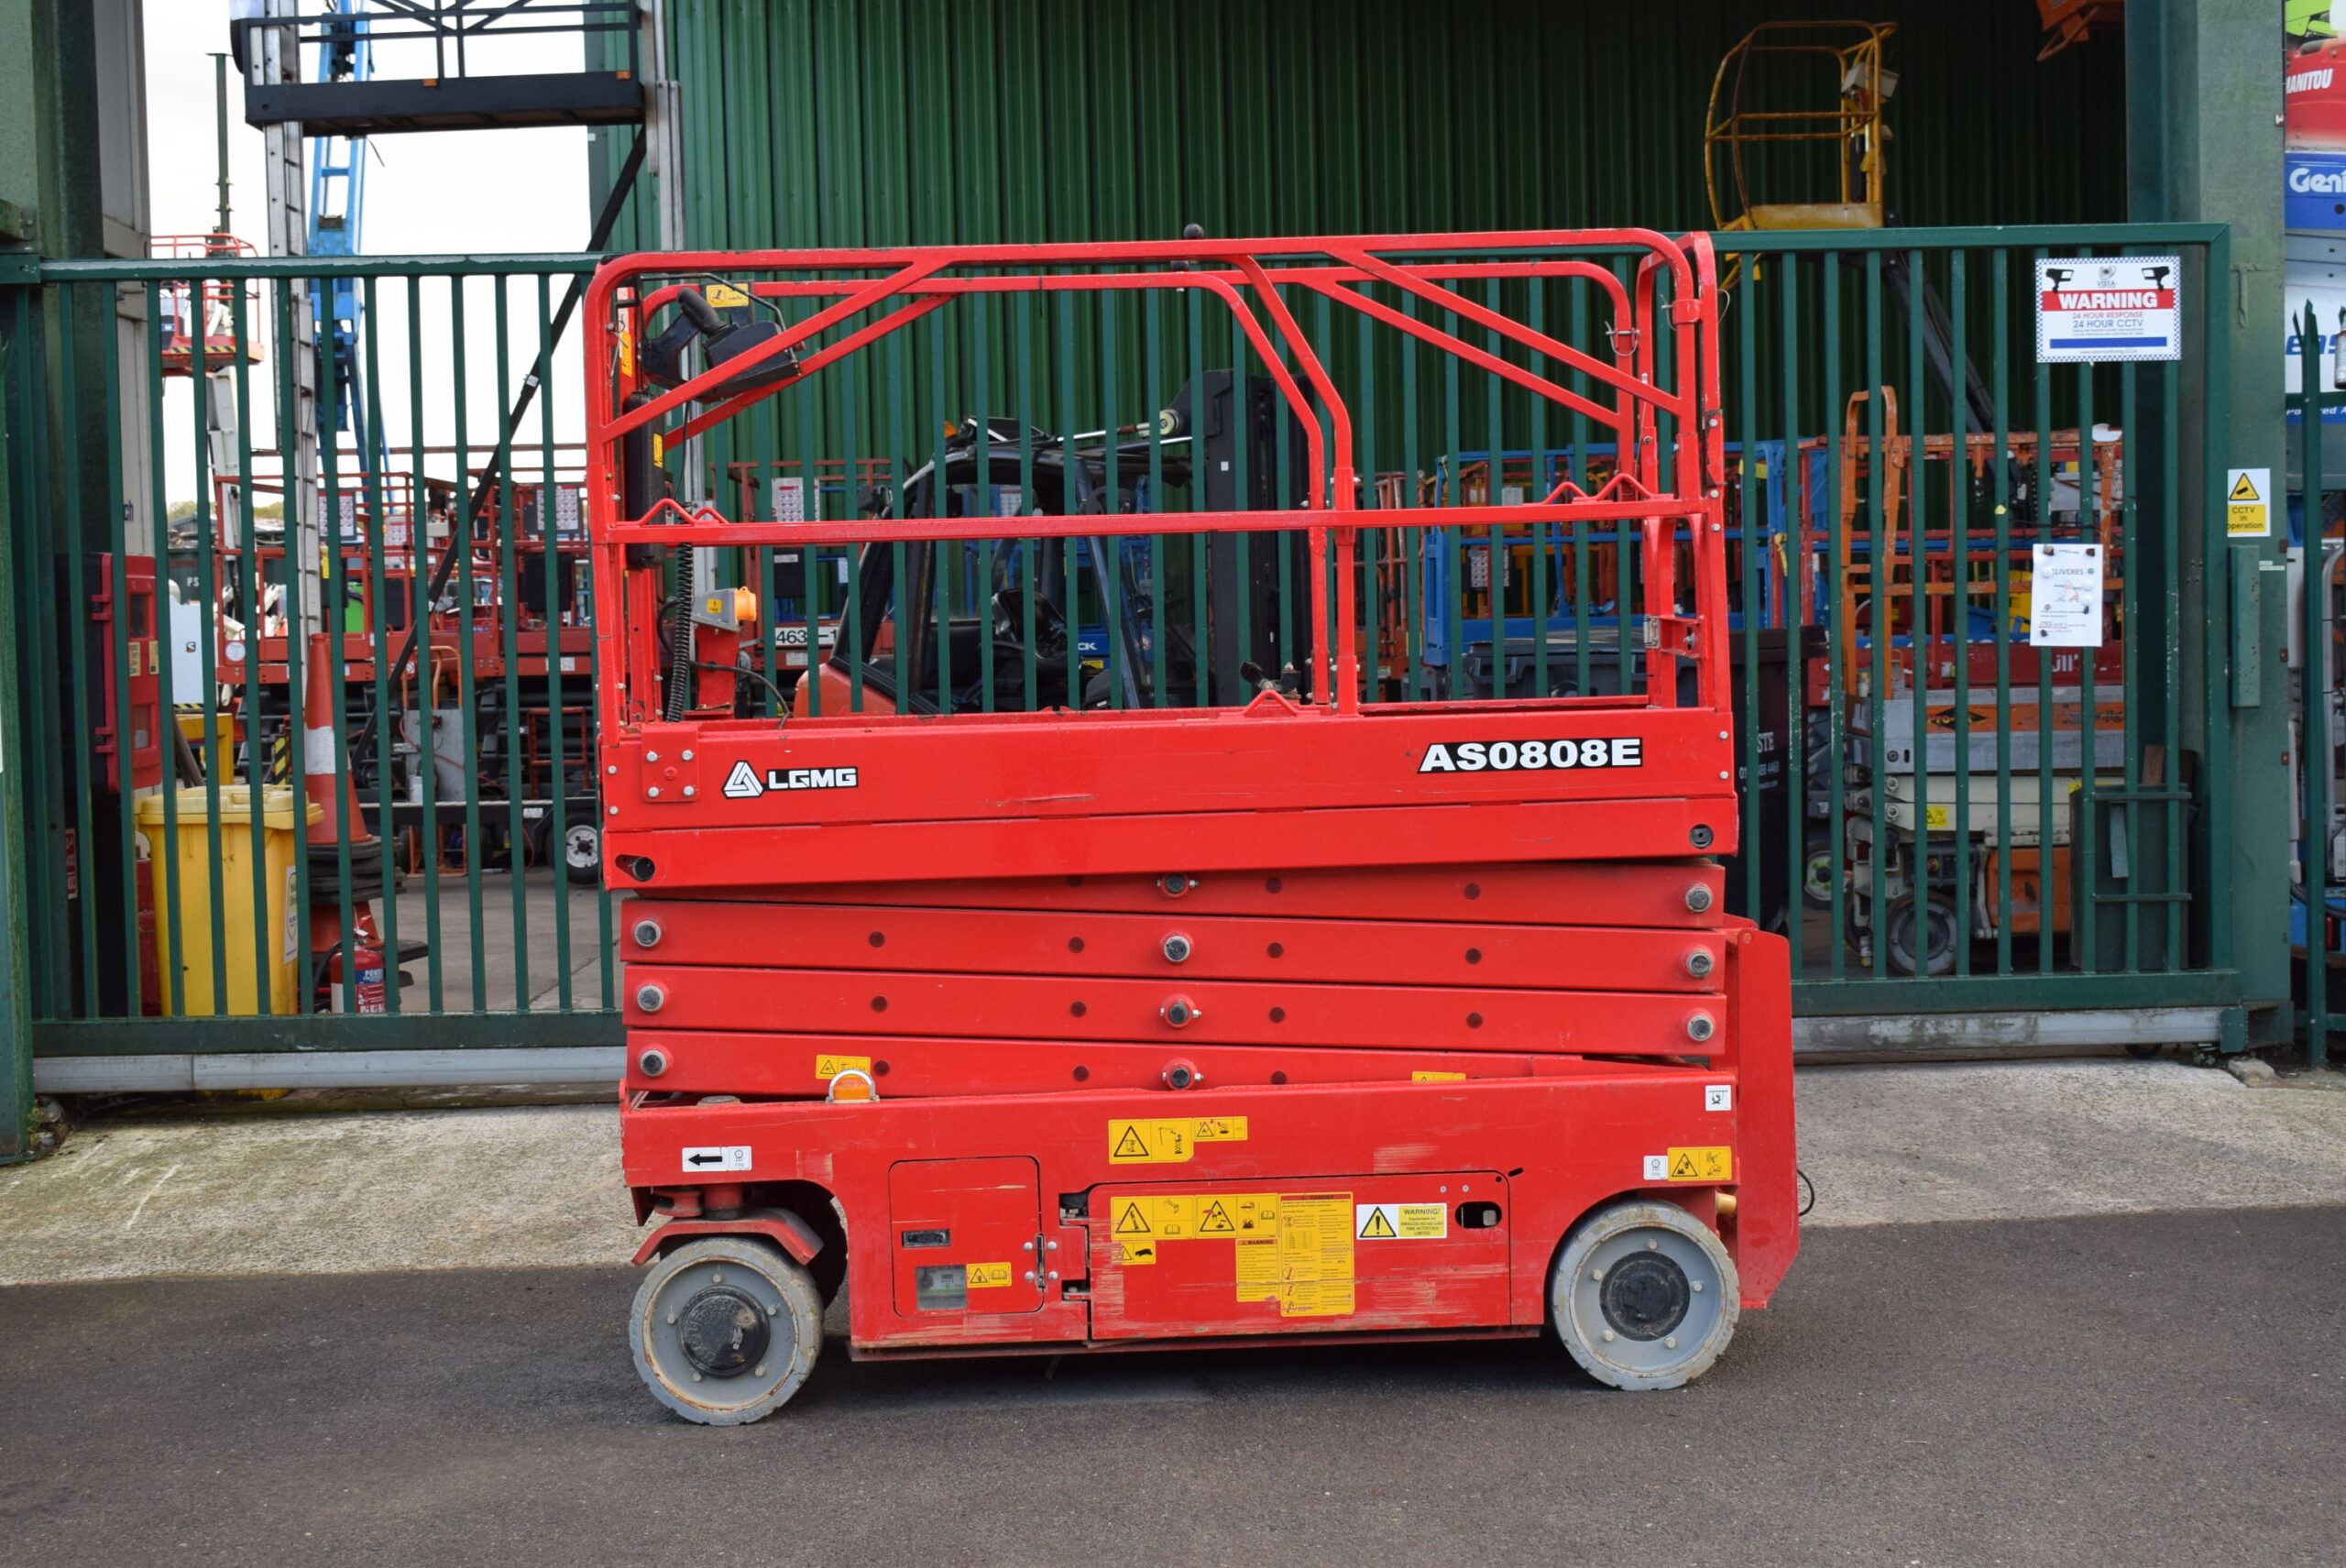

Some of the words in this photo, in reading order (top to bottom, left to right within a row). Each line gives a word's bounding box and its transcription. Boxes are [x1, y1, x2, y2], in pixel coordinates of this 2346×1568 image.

[2058, 291, 2158, 309] WARNING
[2073, 320, 2084, 328] 24
[2087, 320, 2113, 328] HOUR
[2117, 319, 2144, 327] CCTV
[1757, 731, 1775, 753] STE
[1420, 738, 1641, 773] AS0808E
[768, 767, 858, 790] LGMG
[1404, 1208, 1442, 1216] WARNING!
